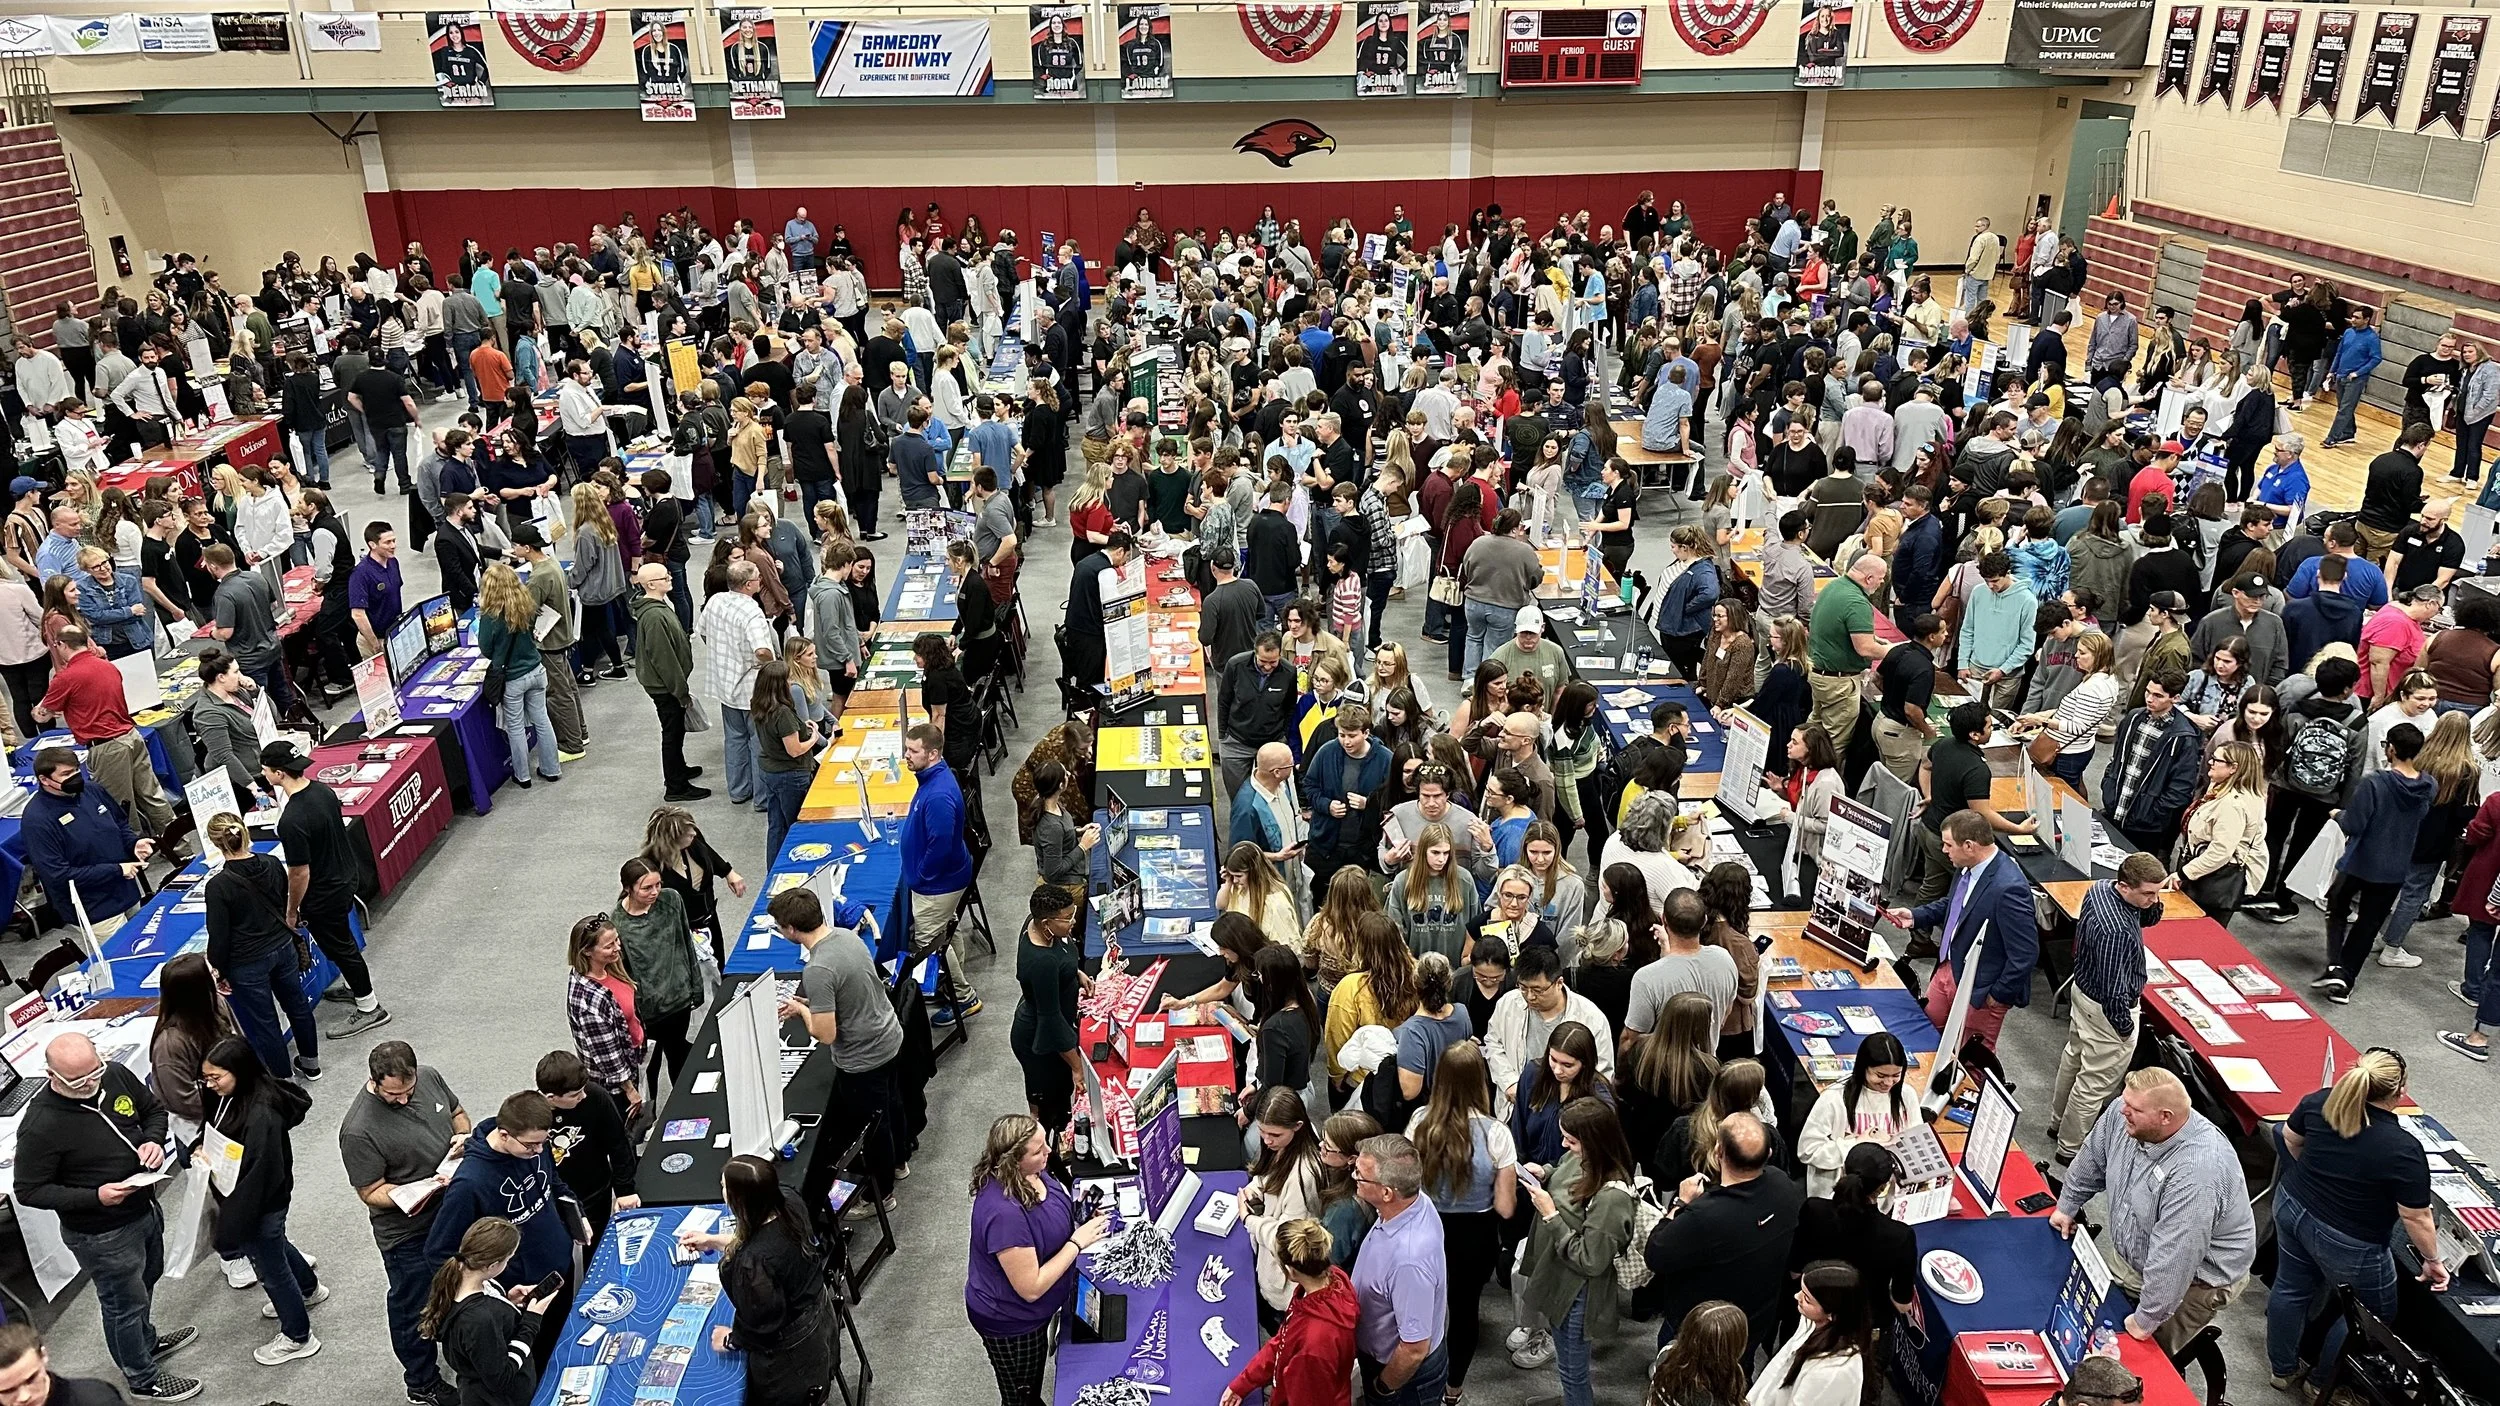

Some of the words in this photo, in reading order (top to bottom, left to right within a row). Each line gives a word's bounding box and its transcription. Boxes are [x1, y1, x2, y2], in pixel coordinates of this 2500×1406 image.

[2017, 1, 2050, 9] Athletic
[2099, 0, 2138, 8] Provided
[152, 16, 183, 28] MSA
[862, 34, 942, 50] GAMEDAY
[2041, 26, 2102, 43] UPMC
[1510, 41, 1540, 53] HOME
[1560, 46, 1585, 55] PERIOD
[1603, 40, 1636, 51] GUEST
[2038, 51, 2072, 60] SPORTS
[2074, 51, 2115, 60] MEDICINE
[859, 73, 897, 82] EXPERIENCE
[1424, 71, 1460, 86] EMILY
[1798, 64, 1843, 79] MADISON
[645, 82, 687, 96] SYDNEY
[730, 80, 779, 94] BETHANY
[1125, 75, 1169, 90] LAUREN
[645, 107, 693, 119] SENIOR
[735, 105, 782, 118] SENIOR
[240, 437, 268, 458] Dickinson
[189, 788, 200, 798] AT
[191, 784, 223, 806] GLANCE
[388, 771, 422, 829] IUP
[1847, 806, 1882, 830] SHENANDOAH
[141, 905, 166, 935] HOFSTRA
[1123, 974, 1156, 1006] STATE
[1209, 1199, 1230, 1221] nu?
[625, 1236, 643, 1263] MOUNT
[1131, 1309, 1162, 1359] NIAGARA
[1150, 1309, 1168, 1361] UNIVERSITY
